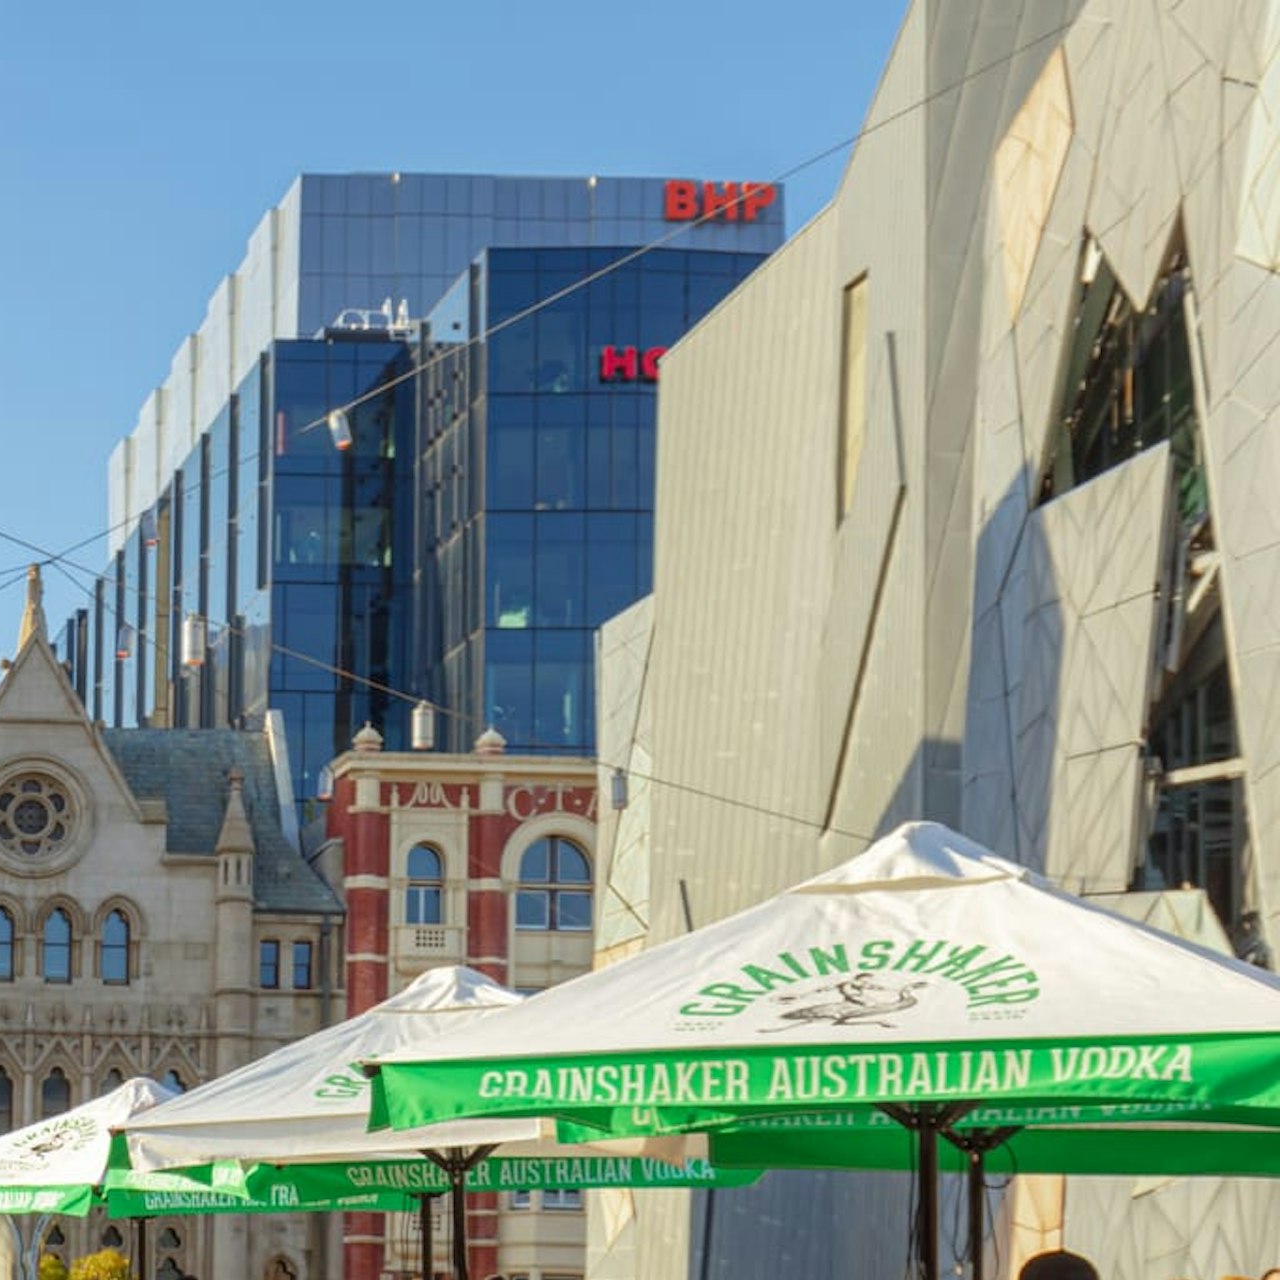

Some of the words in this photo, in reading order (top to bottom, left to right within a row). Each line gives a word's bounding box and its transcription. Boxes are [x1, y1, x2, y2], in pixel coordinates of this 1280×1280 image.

[663, 179, 777, 222] BHP
[680, 940, 1041, 1018] GRAINSHAKER
[478, 1059, 750, 1104] GRAINSHAKER
[768, 1048, 1032, 1101] AUSTRALIAN
[1049, 1043, 1193, 1083] VODKA
[347, 1157, 492, 1188] GRAINSHAER
[499, 1157, 632, 1186] AUSTRALIAN
